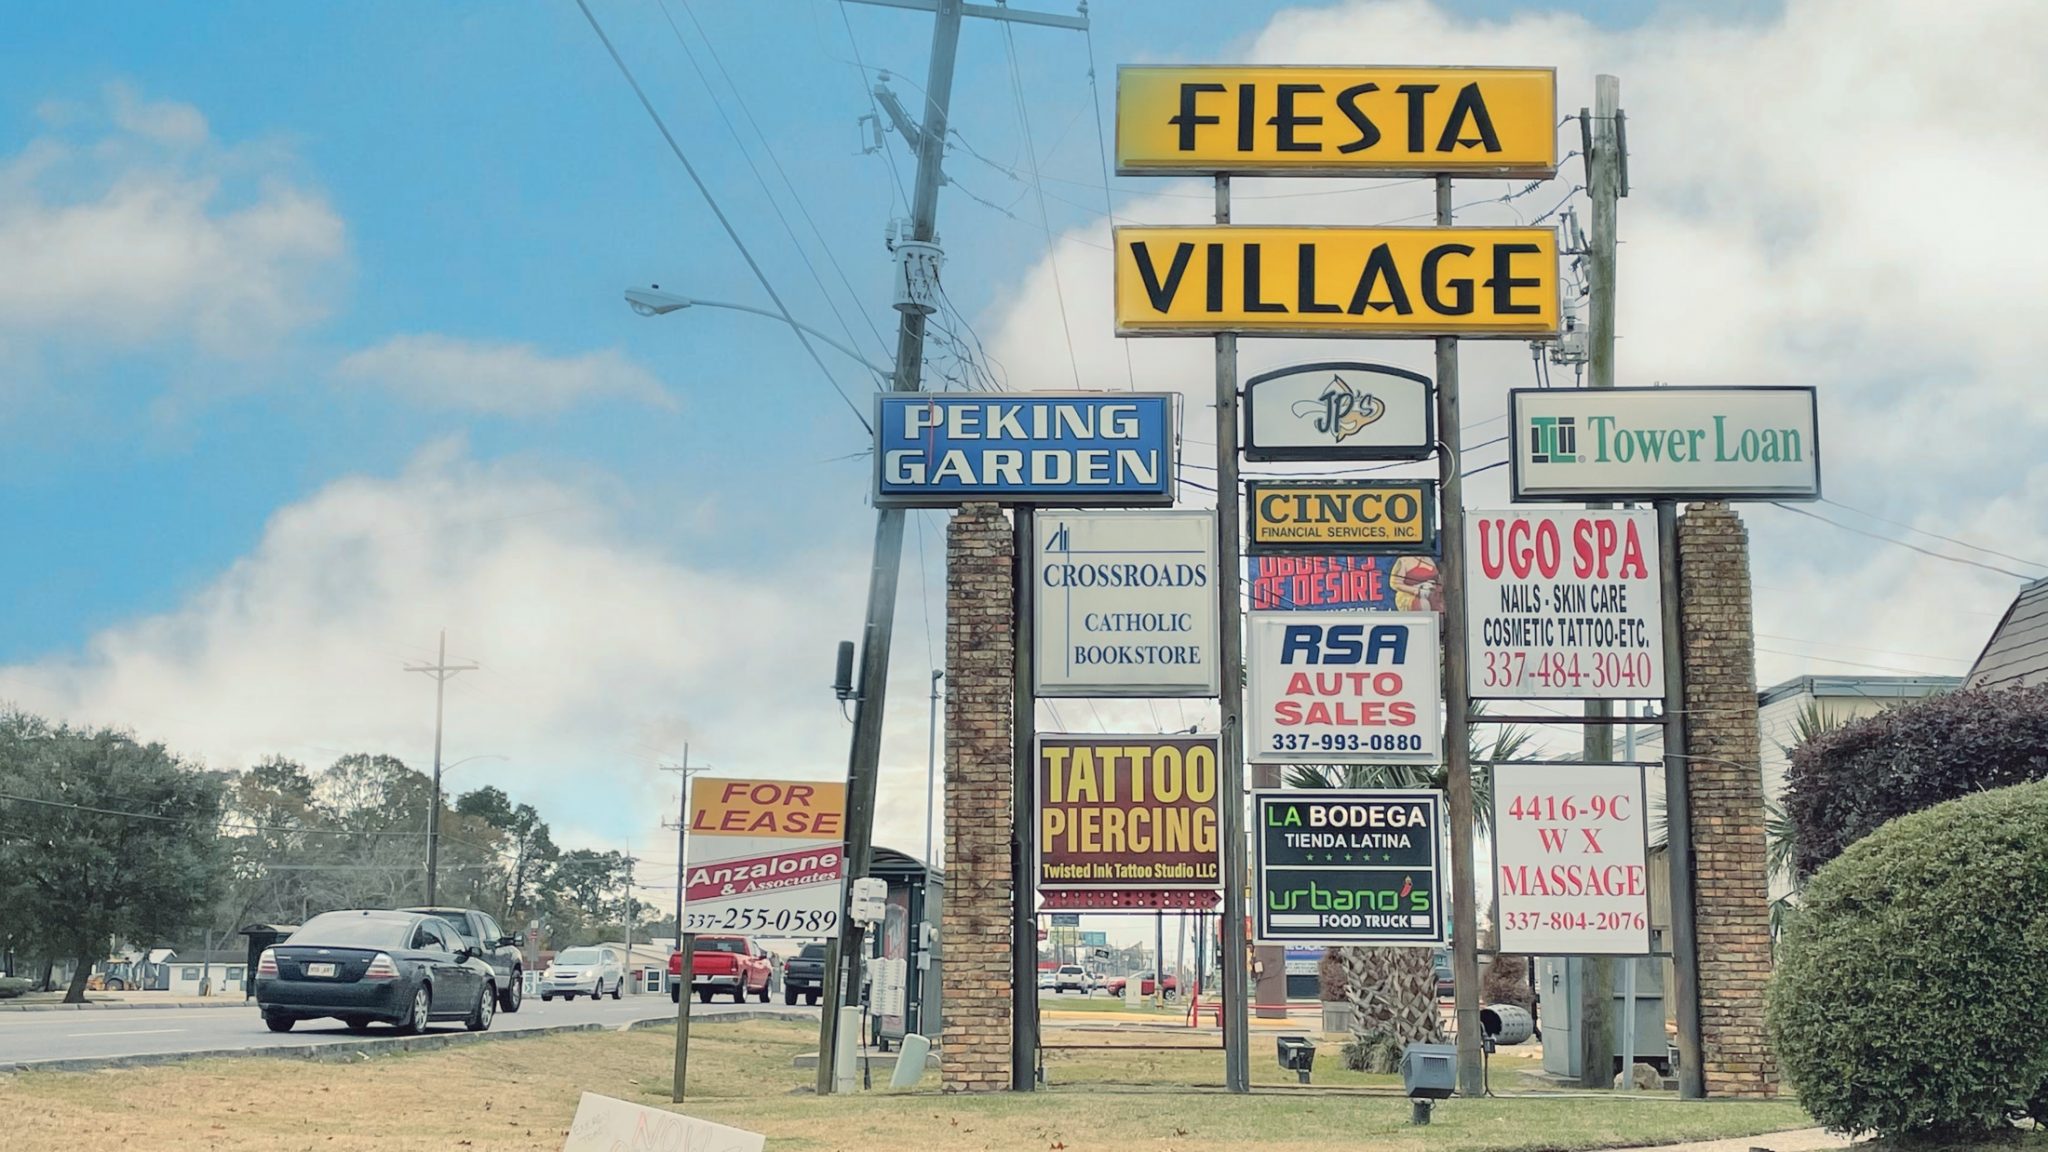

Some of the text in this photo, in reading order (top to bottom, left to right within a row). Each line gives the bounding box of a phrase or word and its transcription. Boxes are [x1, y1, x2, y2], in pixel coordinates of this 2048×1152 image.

[1168, 81, 1503, 154] FIESTA
[1130, 241, 1542, 316] VILLAGE
[904, 404, 1139, 439] PEKING
[1587, 416, 1803, 464] Tower Loan
[885, 449, 1158, 485] GARDEN
[1260, 493, 1418, 524] CINCO
[1261, 527, 1417, 540] FINANCIAL SERVICES, INC.
[1478, 518, 1648, 580] UGO SPA
[1043, 563, 1207, 588] CROSSROADS
[1254, 570, 1384, 609] OF DESIRE
[1500, 584, 1541, 613] NAILS
[1553, 584, 1586, 613] SKIN
[1590, 584, 1627, 613] CARE
[1085, 612, 1192, 632] CATHOLIC
[1483, 617, 1554, 647] COSMETIC
[1074, 645, 1201, 665] BOOKSTORE
[1280, 624, 1409, 665] RSA
[1483, 651, 1651, 688] 337-484-3040
[1286, 672, 1403, 696] AUTO
[1274, 701, 1416, 727] SALES
[1272, 734, 1421, 750] 337-993-0880
[1042, 745, 1215, 803] TATTOO
[721, 783, 815, 806] FOR
[1268, 806, 1426, 827] LA BODEGA
[1509, 795, 1630, 821] 4416-9C
[693, 809, 841, 834] LEASE
[1042, 807, 1216, 852] PIERCING
[1285, 833, 1411, 848] TIENDA LATINA
[1538, 829, 1603, 854] W X
[688, 853, 838, 888] Anzalone
[720, 871, 836, 895] & Associates
[1043, 863, 1217, 878] Twisted Ink Tattoo Studio LLC
[1501, 865, 1645, 896] MASSAGE
[687, 908, 837, 932] 337-255-0589
[1322, 914, 1409, 928] FOOD TRUCK
[1505, 912, 1645, 930] 337-804-2076
